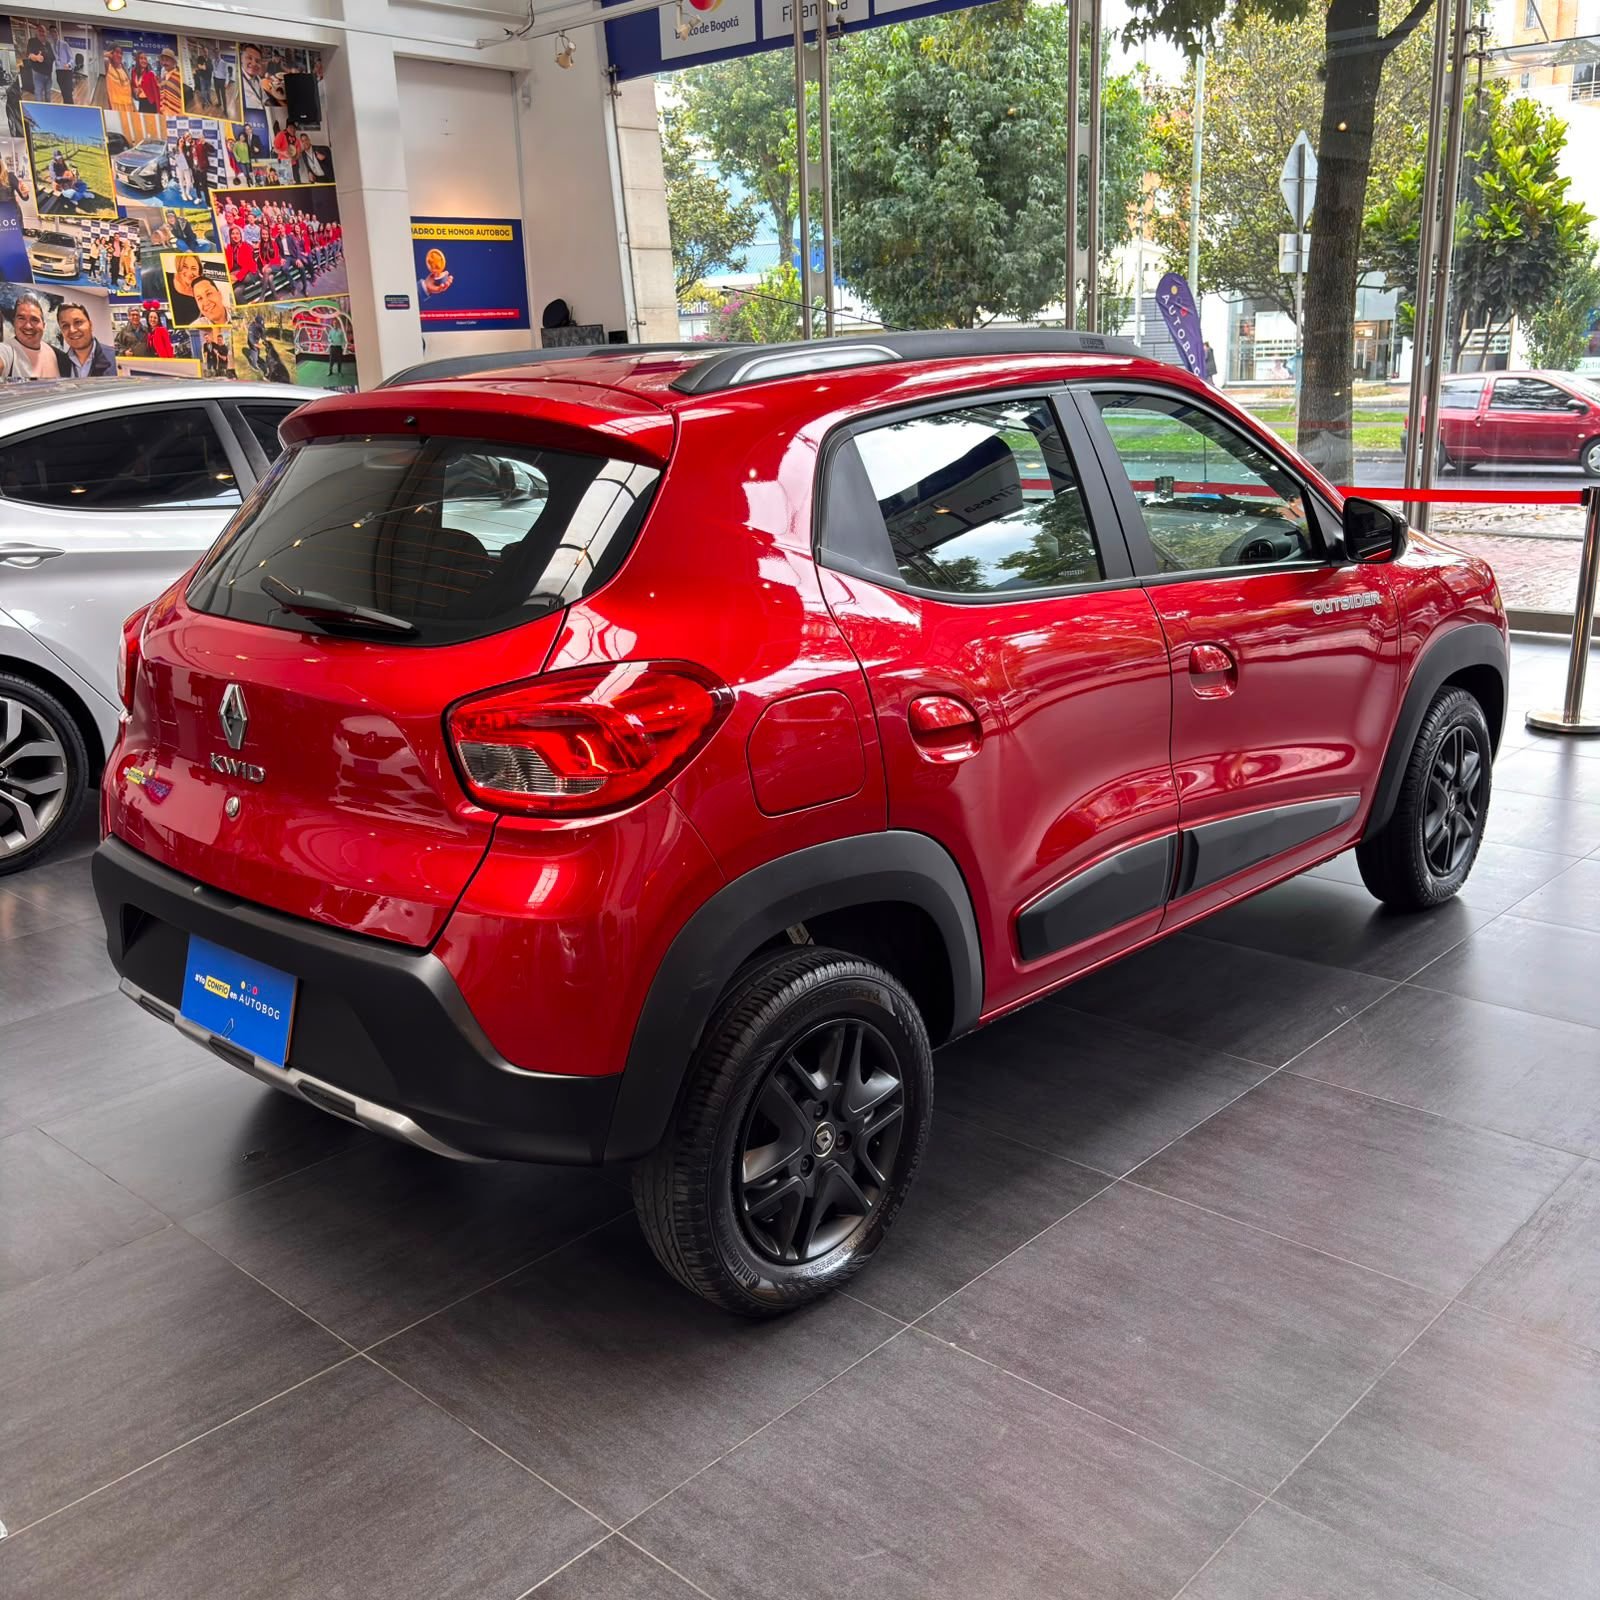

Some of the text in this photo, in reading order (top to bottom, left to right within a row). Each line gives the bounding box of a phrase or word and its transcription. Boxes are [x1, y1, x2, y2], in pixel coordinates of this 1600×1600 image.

[674, 15, 739, 39] Bco de Bogotá
[411, 227, 435, 235] ADRO
[436, 228, 447, 236] DE
[448, 228, 475, 236] HONOR
[1312, 591, 1382, 615] OUTSIDER
[209, 752, 266, 783] KWID
[239, 993, 280, 1020] AUTOBOG
